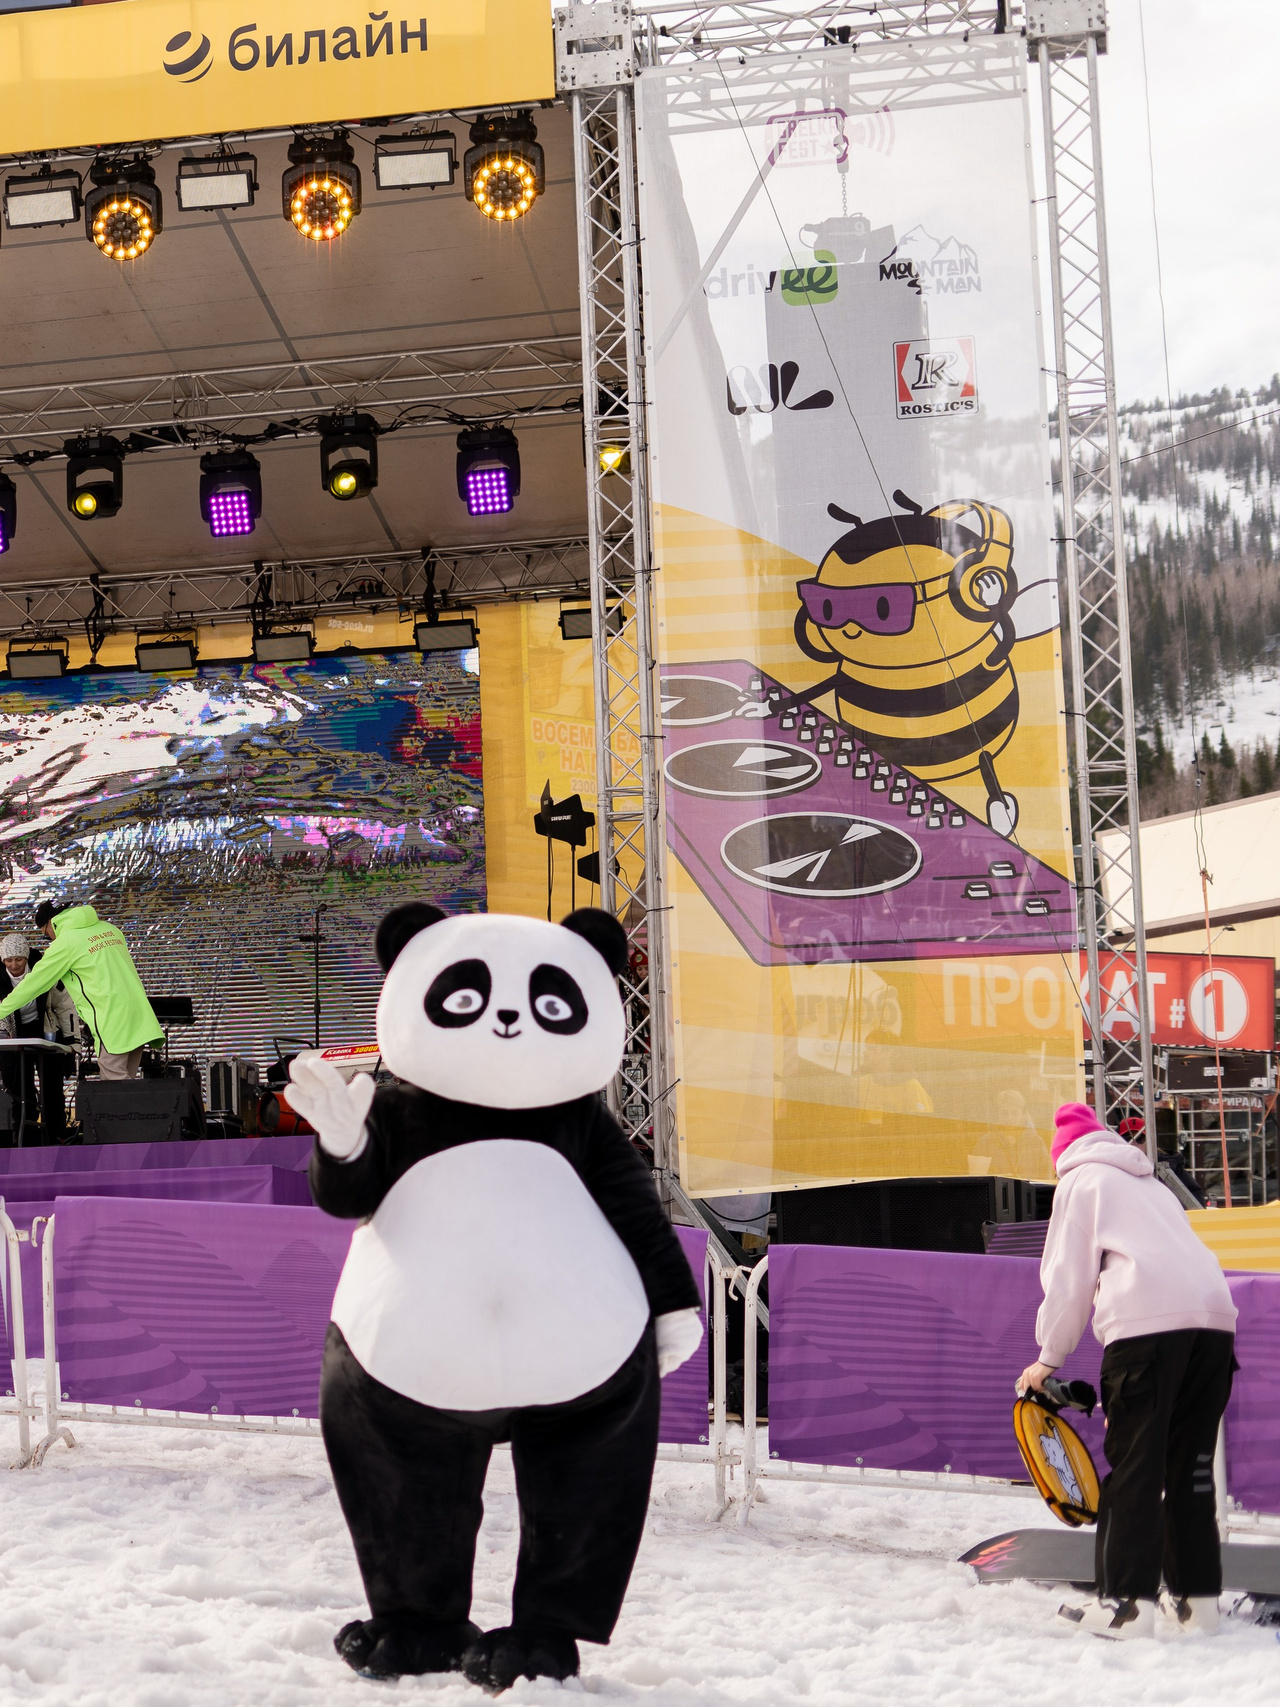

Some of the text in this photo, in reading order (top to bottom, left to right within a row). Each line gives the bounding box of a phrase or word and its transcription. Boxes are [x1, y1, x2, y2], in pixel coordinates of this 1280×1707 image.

[228, 10, 428, 71] билайн
[879, 258, 979, 282] MOUNTAIN
[936, 276, 983, 294] MAN
[901, 401, 974, 415] ROSTIC'S
[551, 814, 572, 822] SHURE
[88, 941, 107, 954] MUSIC
[942, 962, 1167, 1034] ПРОКАТ
[95, 1112, 170, 1121] ProTone
